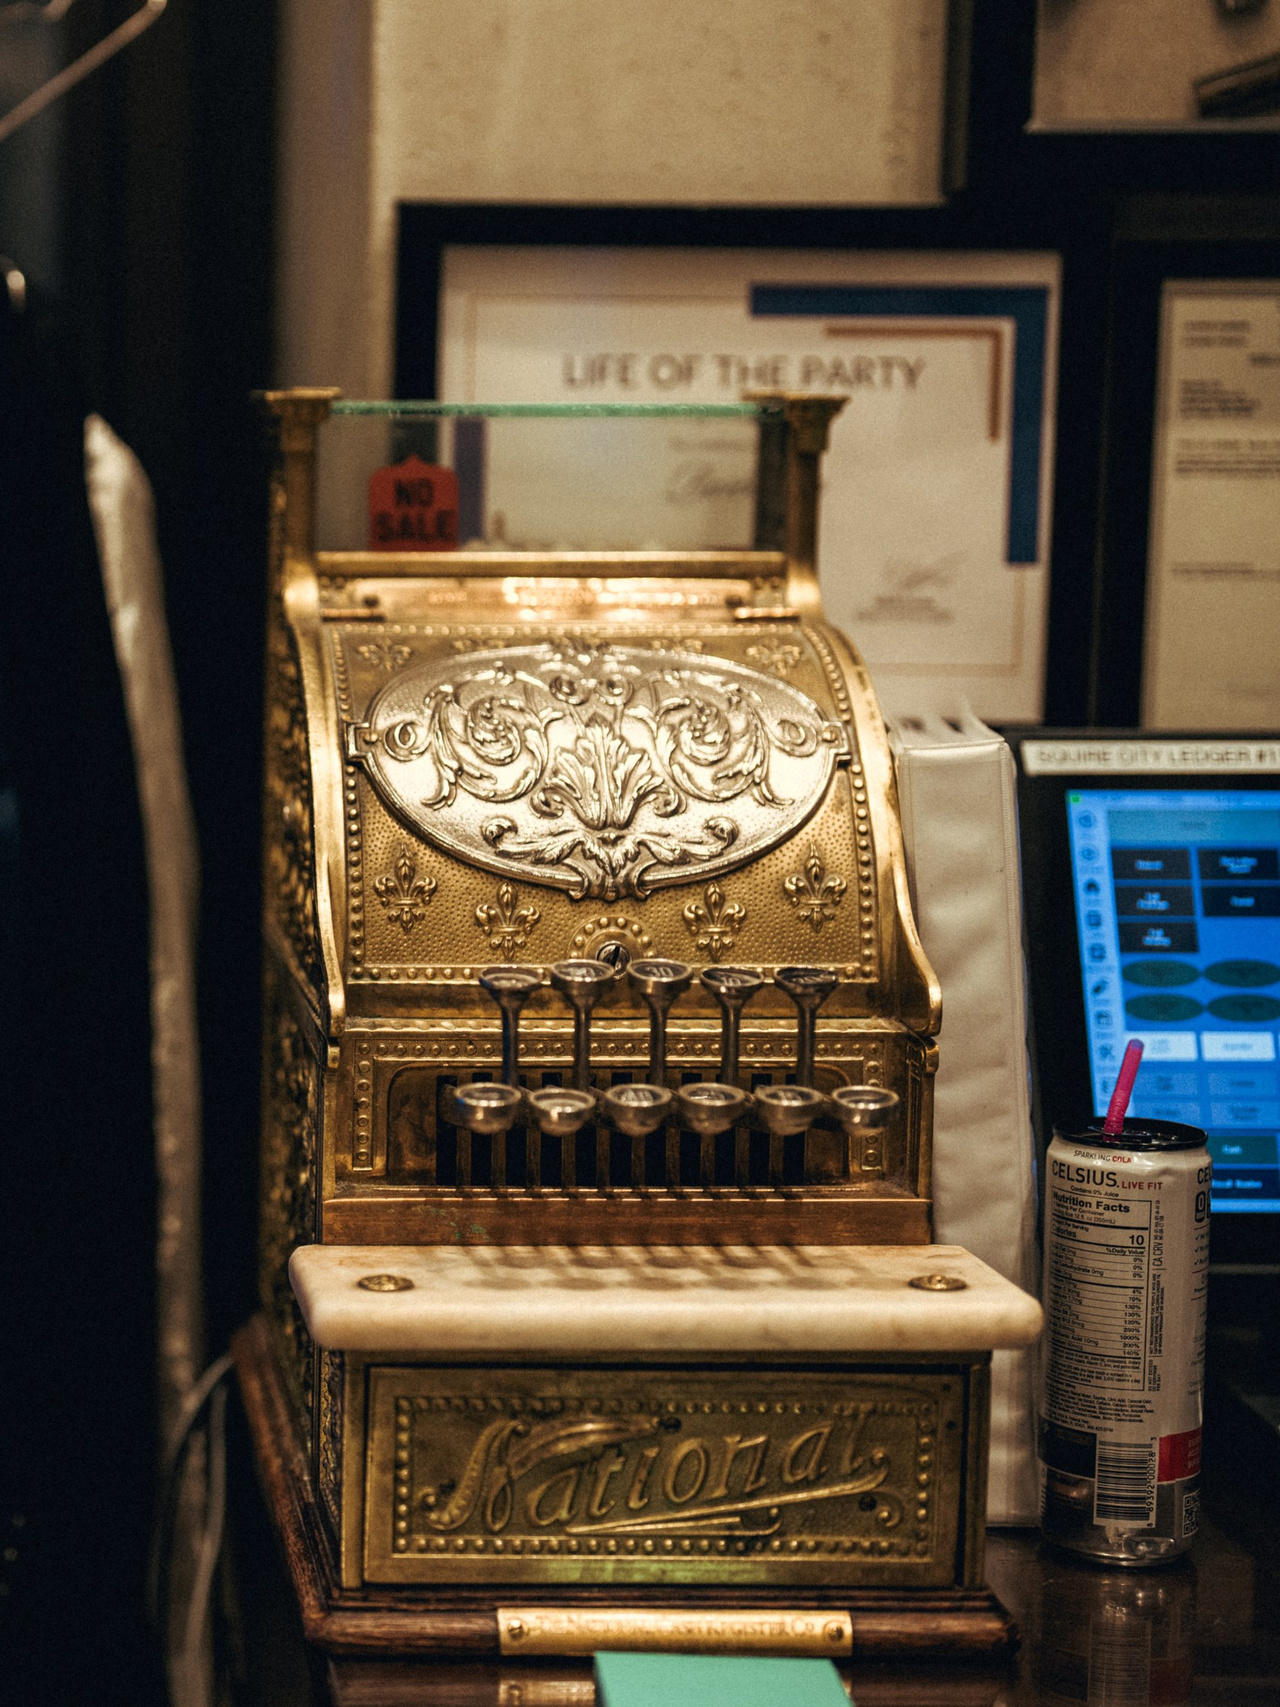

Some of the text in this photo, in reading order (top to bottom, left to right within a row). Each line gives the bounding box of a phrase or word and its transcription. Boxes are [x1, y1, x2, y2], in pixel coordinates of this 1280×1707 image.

[562, 351, 925, 389] LIFE OF THE PARTY
[394, 478, 433, 507] NO
[375, 509, 456, 542] SALE
[1074, 1149, 1132, 1164] SPARKLING COLA
[1121, 1181, 1145, 1190] LIVE
[1147, 1181, 1163, 1191] FIT
[1053, 1191, 1131, 1213] Nutrition Facts
[1128, 1234, 1145, 1246] 10
[1152, 1242, 1164, 1256] CRV
[1152, 1257, 1163, 1267] CA
[421, 1409, 885, 1533] National
